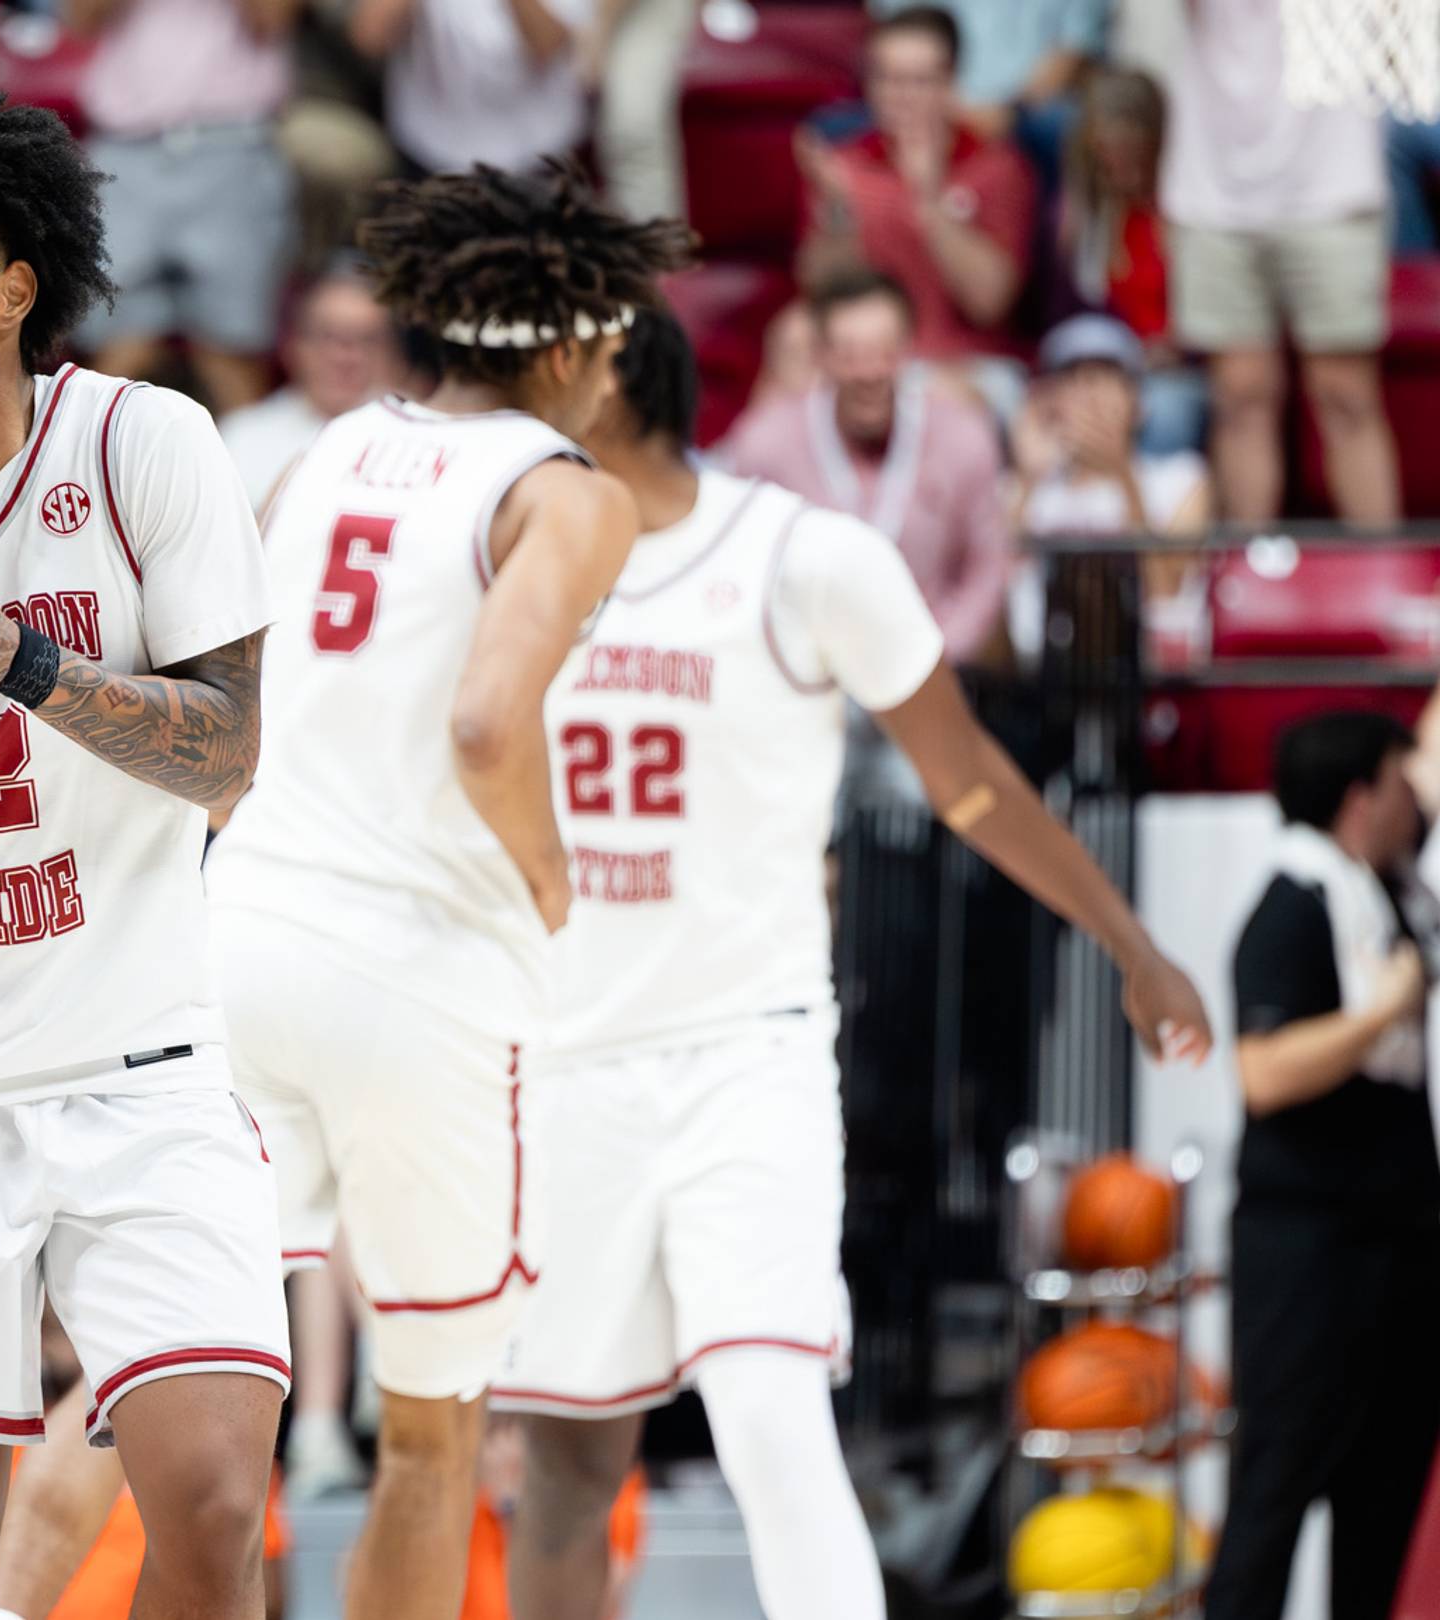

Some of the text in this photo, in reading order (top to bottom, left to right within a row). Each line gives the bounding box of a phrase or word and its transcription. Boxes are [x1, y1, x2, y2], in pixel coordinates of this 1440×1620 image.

[41, 483, 91, 534] SEC
[311, 511, 401, 656] 5
[561, 722, 686, 818] 22
